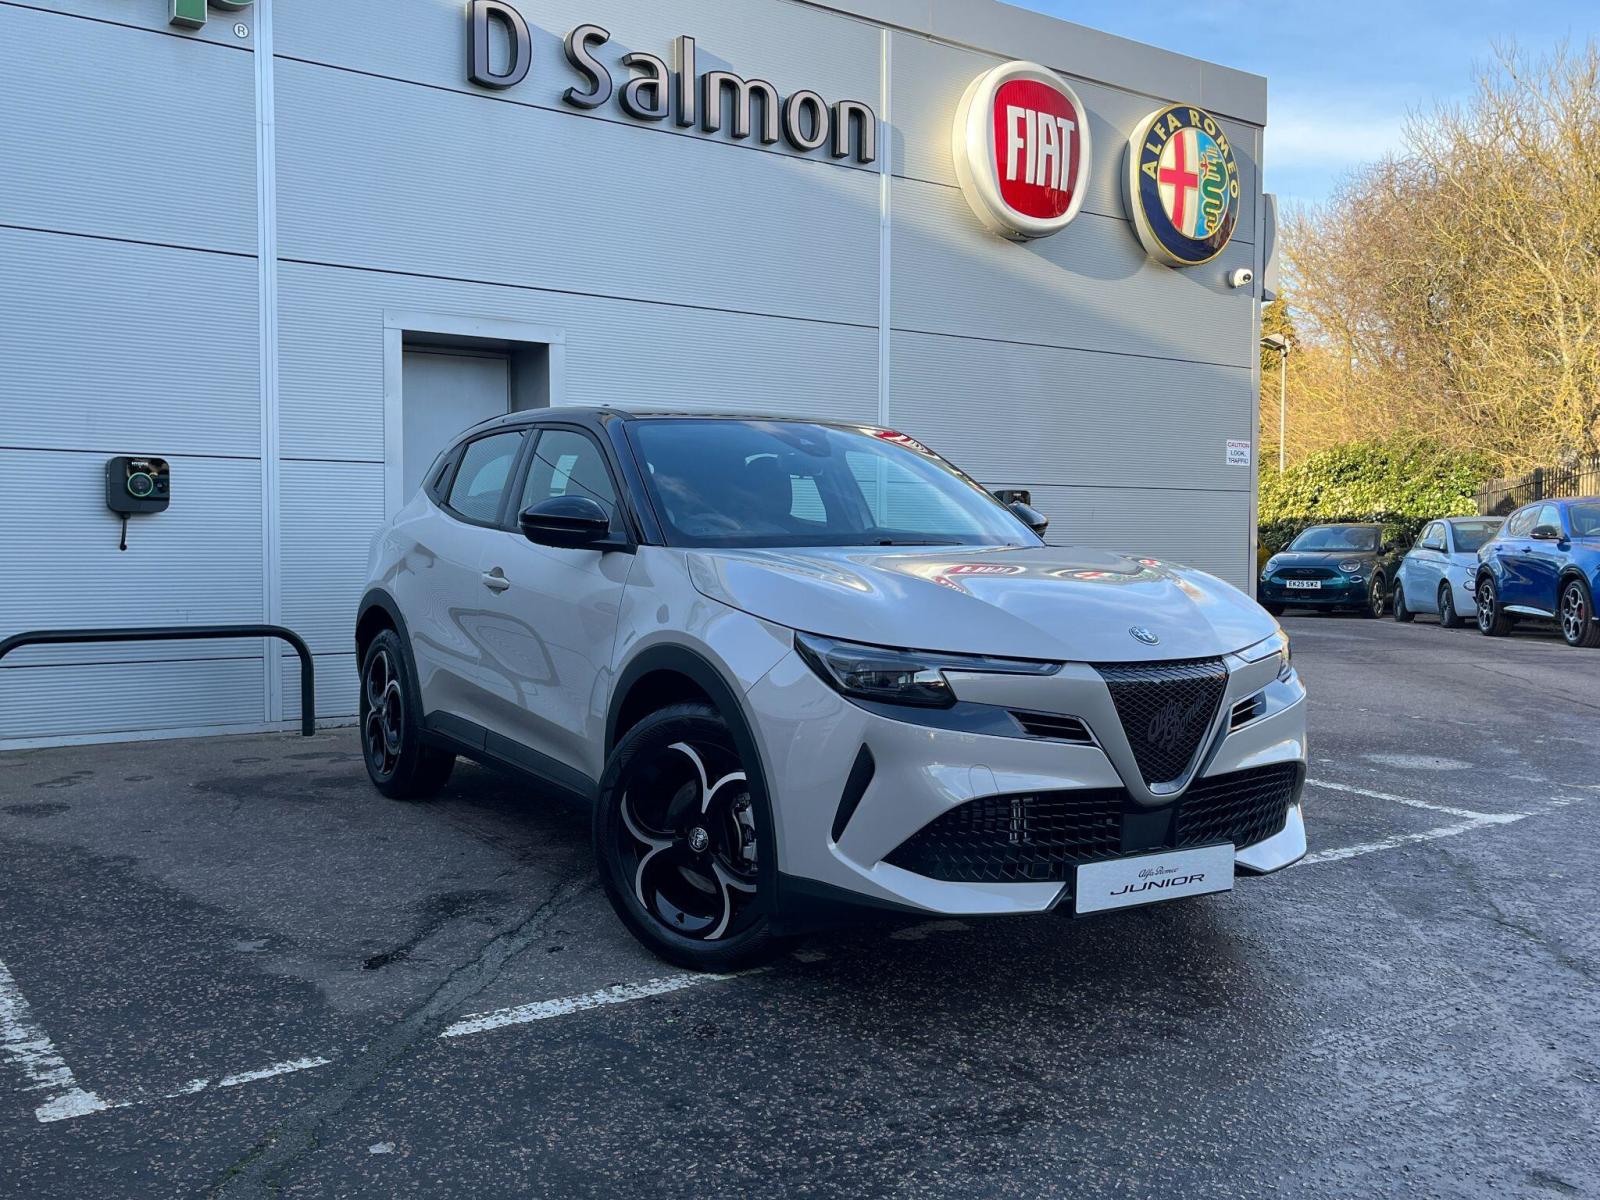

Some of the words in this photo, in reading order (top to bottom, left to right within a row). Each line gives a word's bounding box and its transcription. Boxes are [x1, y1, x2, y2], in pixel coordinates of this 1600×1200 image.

[466, 0, 532, 89] D
[562, 23, 877, 164] Salmon
[1006, 104, 1075, 192] FIAT
[1142, 113, 1182, 180] ALFA
[1189, 109, 1239, 199] ROMEO
[1227, 441, 1250, 449] CAUTION
[1110, 873, 1205, 896] JUNIOR
[1138, 868, 1154, 880] Alfa
